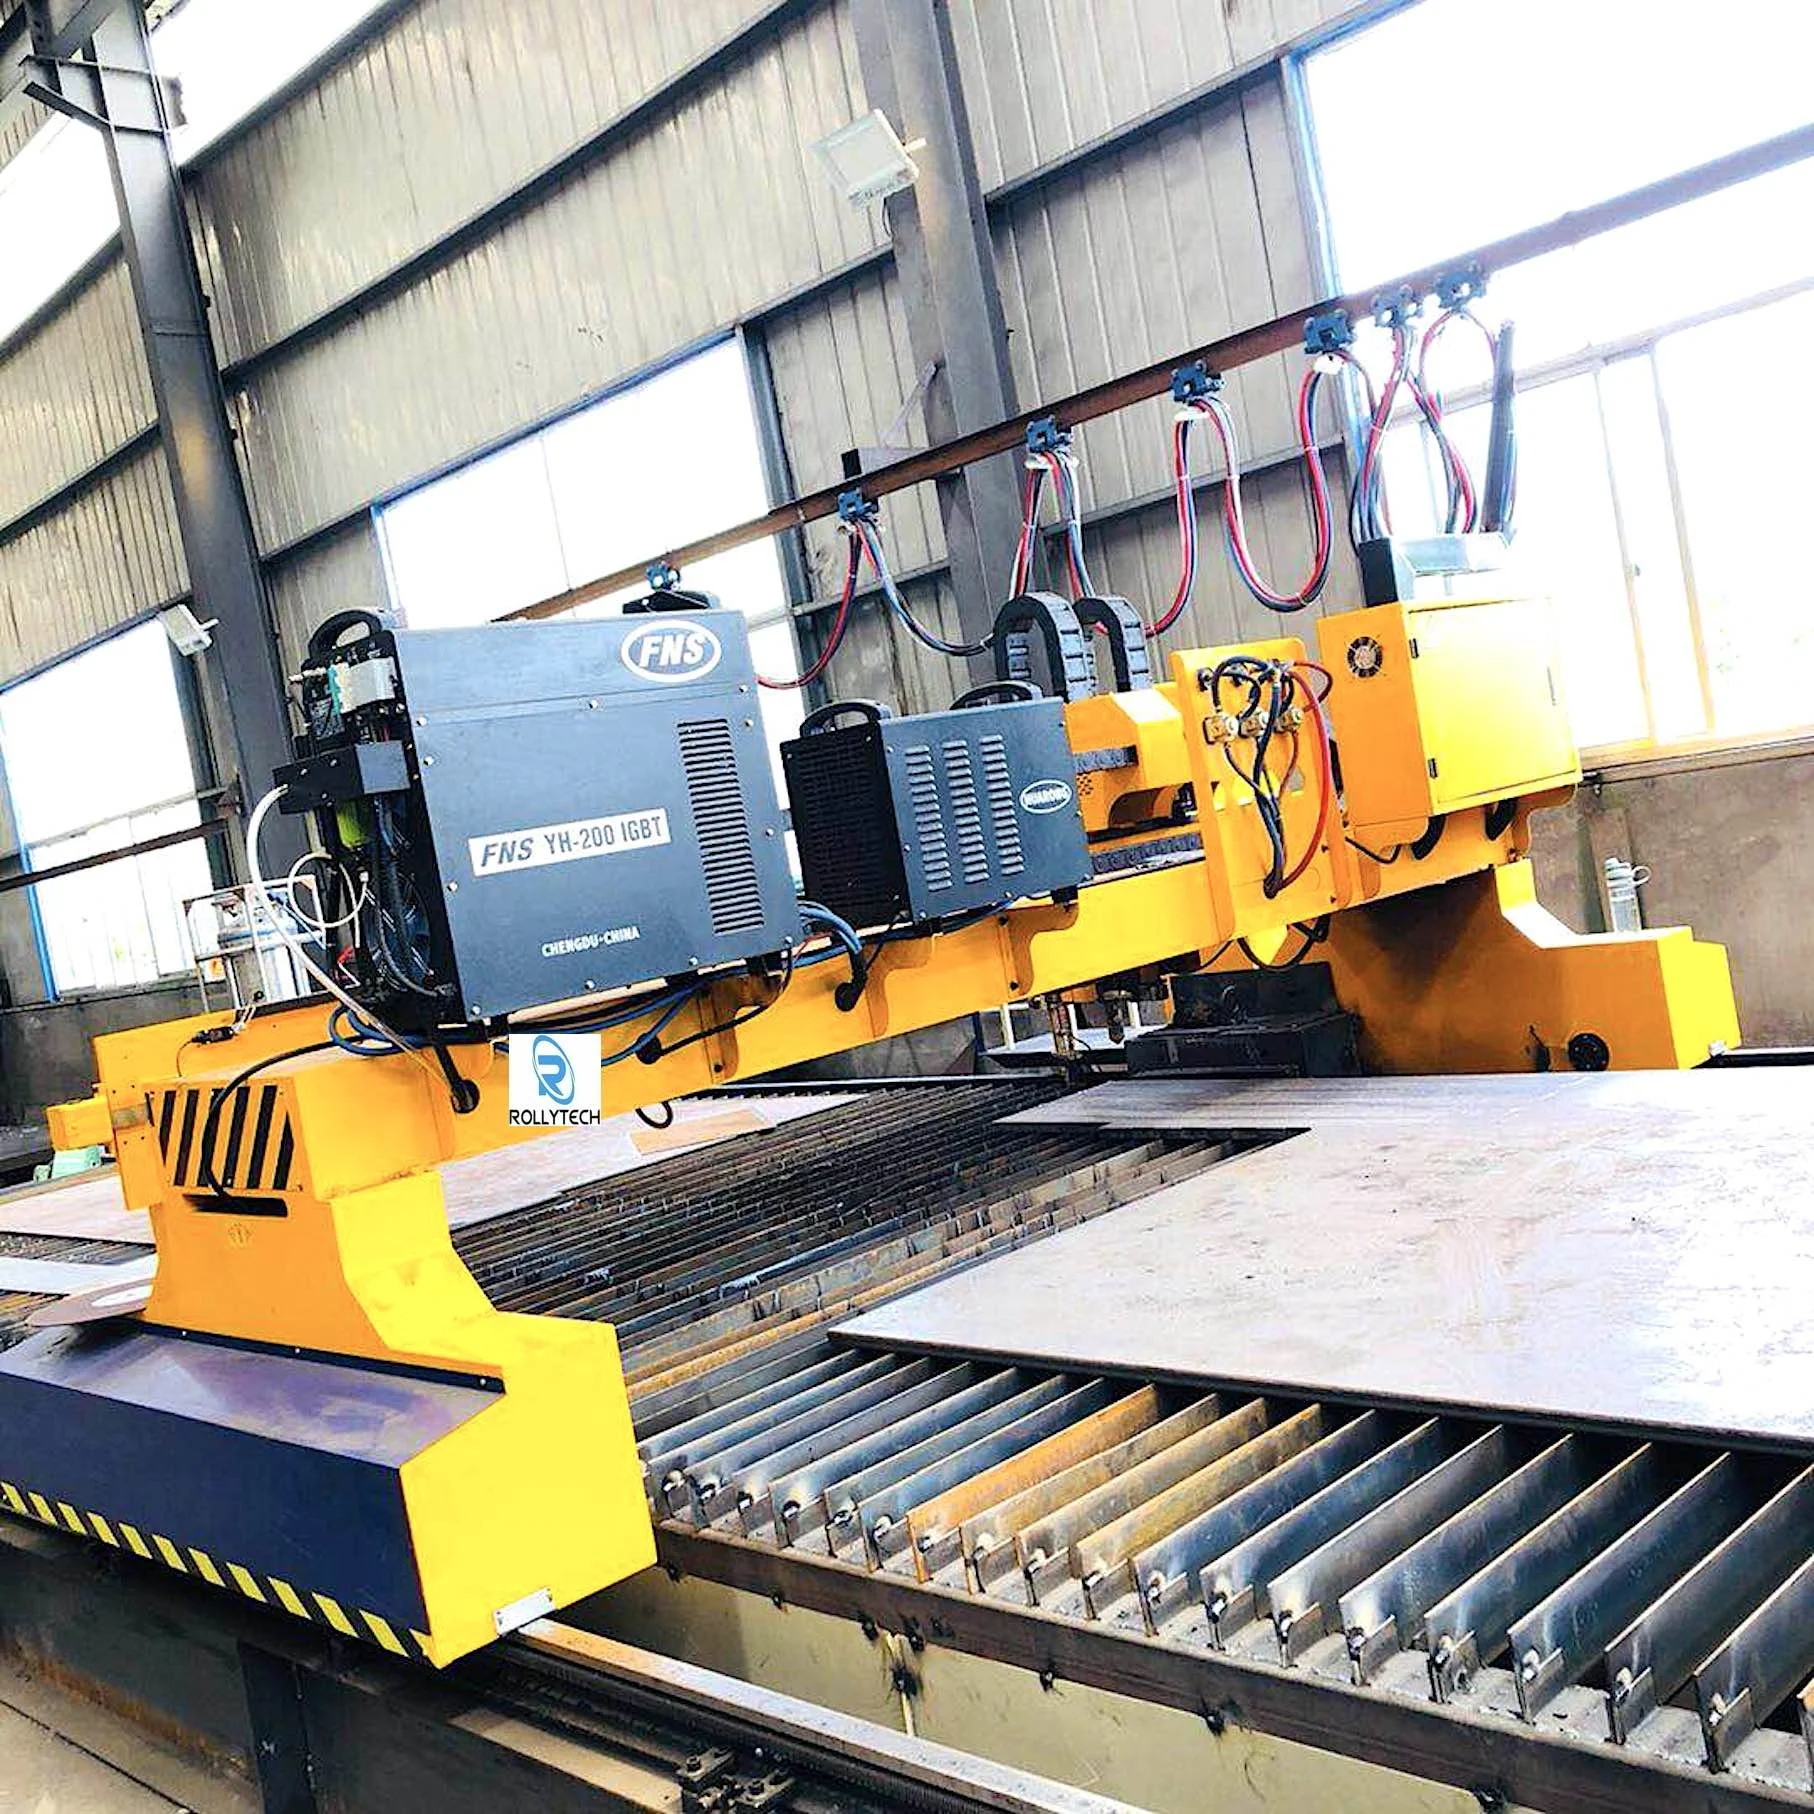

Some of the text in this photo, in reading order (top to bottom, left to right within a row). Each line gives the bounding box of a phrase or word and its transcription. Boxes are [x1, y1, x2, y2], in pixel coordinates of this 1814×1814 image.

[640, 632, 705, 667] FNS
[481, 816, 661, 868] FNS YH-200 IGBT
